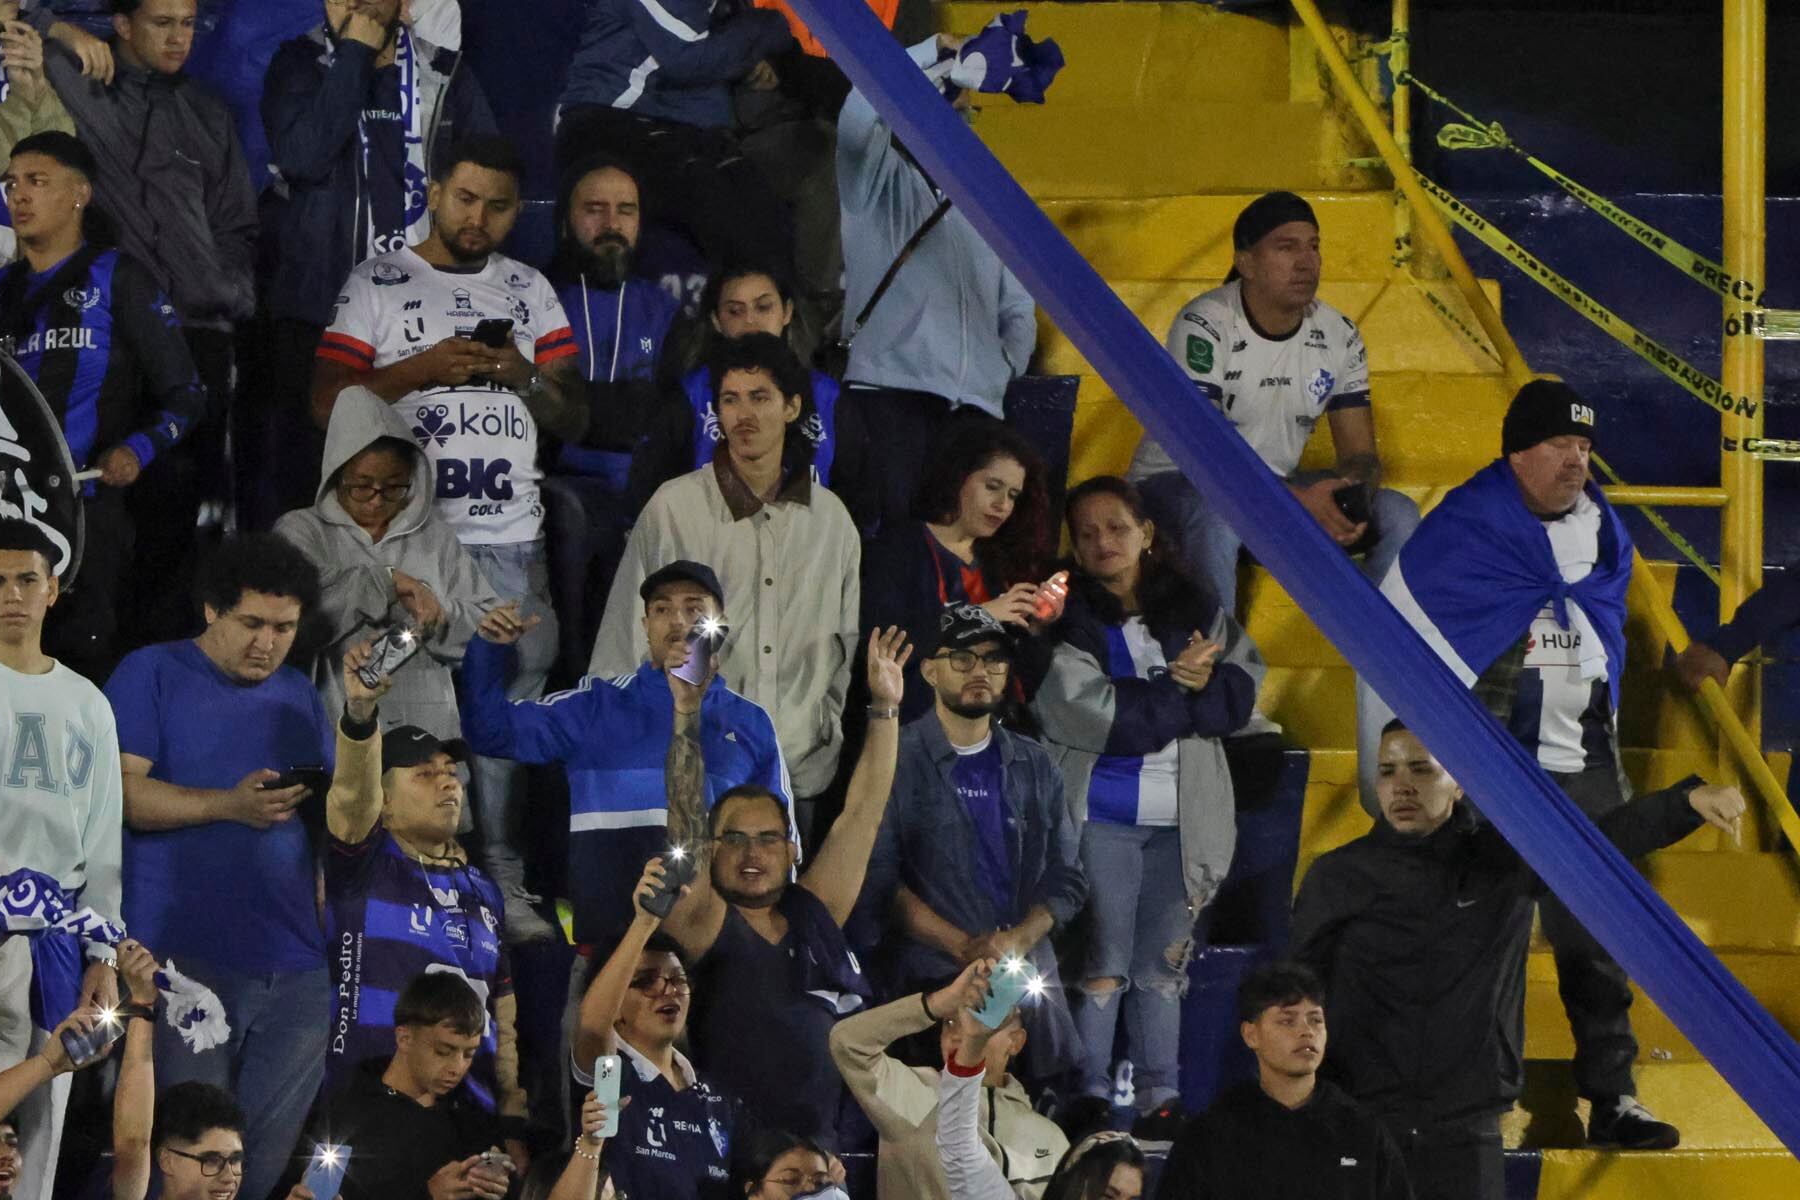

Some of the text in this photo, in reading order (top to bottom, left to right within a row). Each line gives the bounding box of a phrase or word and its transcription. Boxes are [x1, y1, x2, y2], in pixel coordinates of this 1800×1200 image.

[45, 328, 97, 351] AZUL
[1571, 403, 1594, 426] CAT
[435, 457, 514, 502] BIG
[469, 504, 503, 516] COLA
[333, 931, 354, 1055] Pedro Don
[635, 1145, 678, 1161] San Marcos
